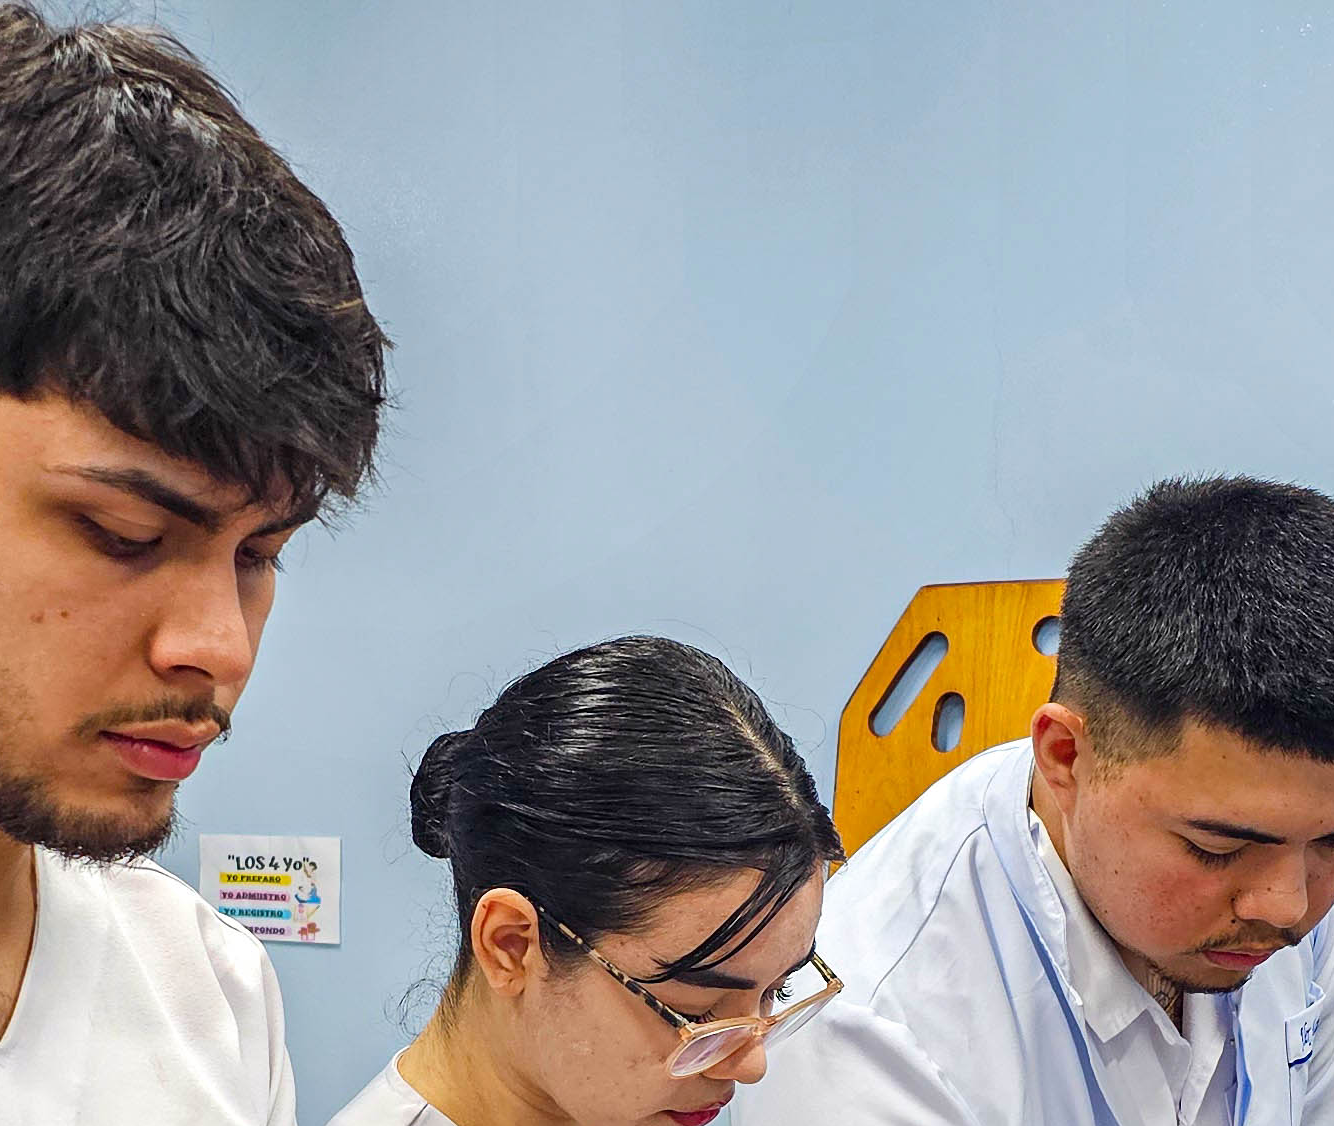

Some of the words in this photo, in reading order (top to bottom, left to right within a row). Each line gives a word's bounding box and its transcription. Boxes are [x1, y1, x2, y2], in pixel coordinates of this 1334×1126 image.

[269, 856, 280, 870] 4
[227, 875, 238, 883] YO
[241, 875, 281, 884] PREPARO
[238, 908, 283, 918] REGISTRO
